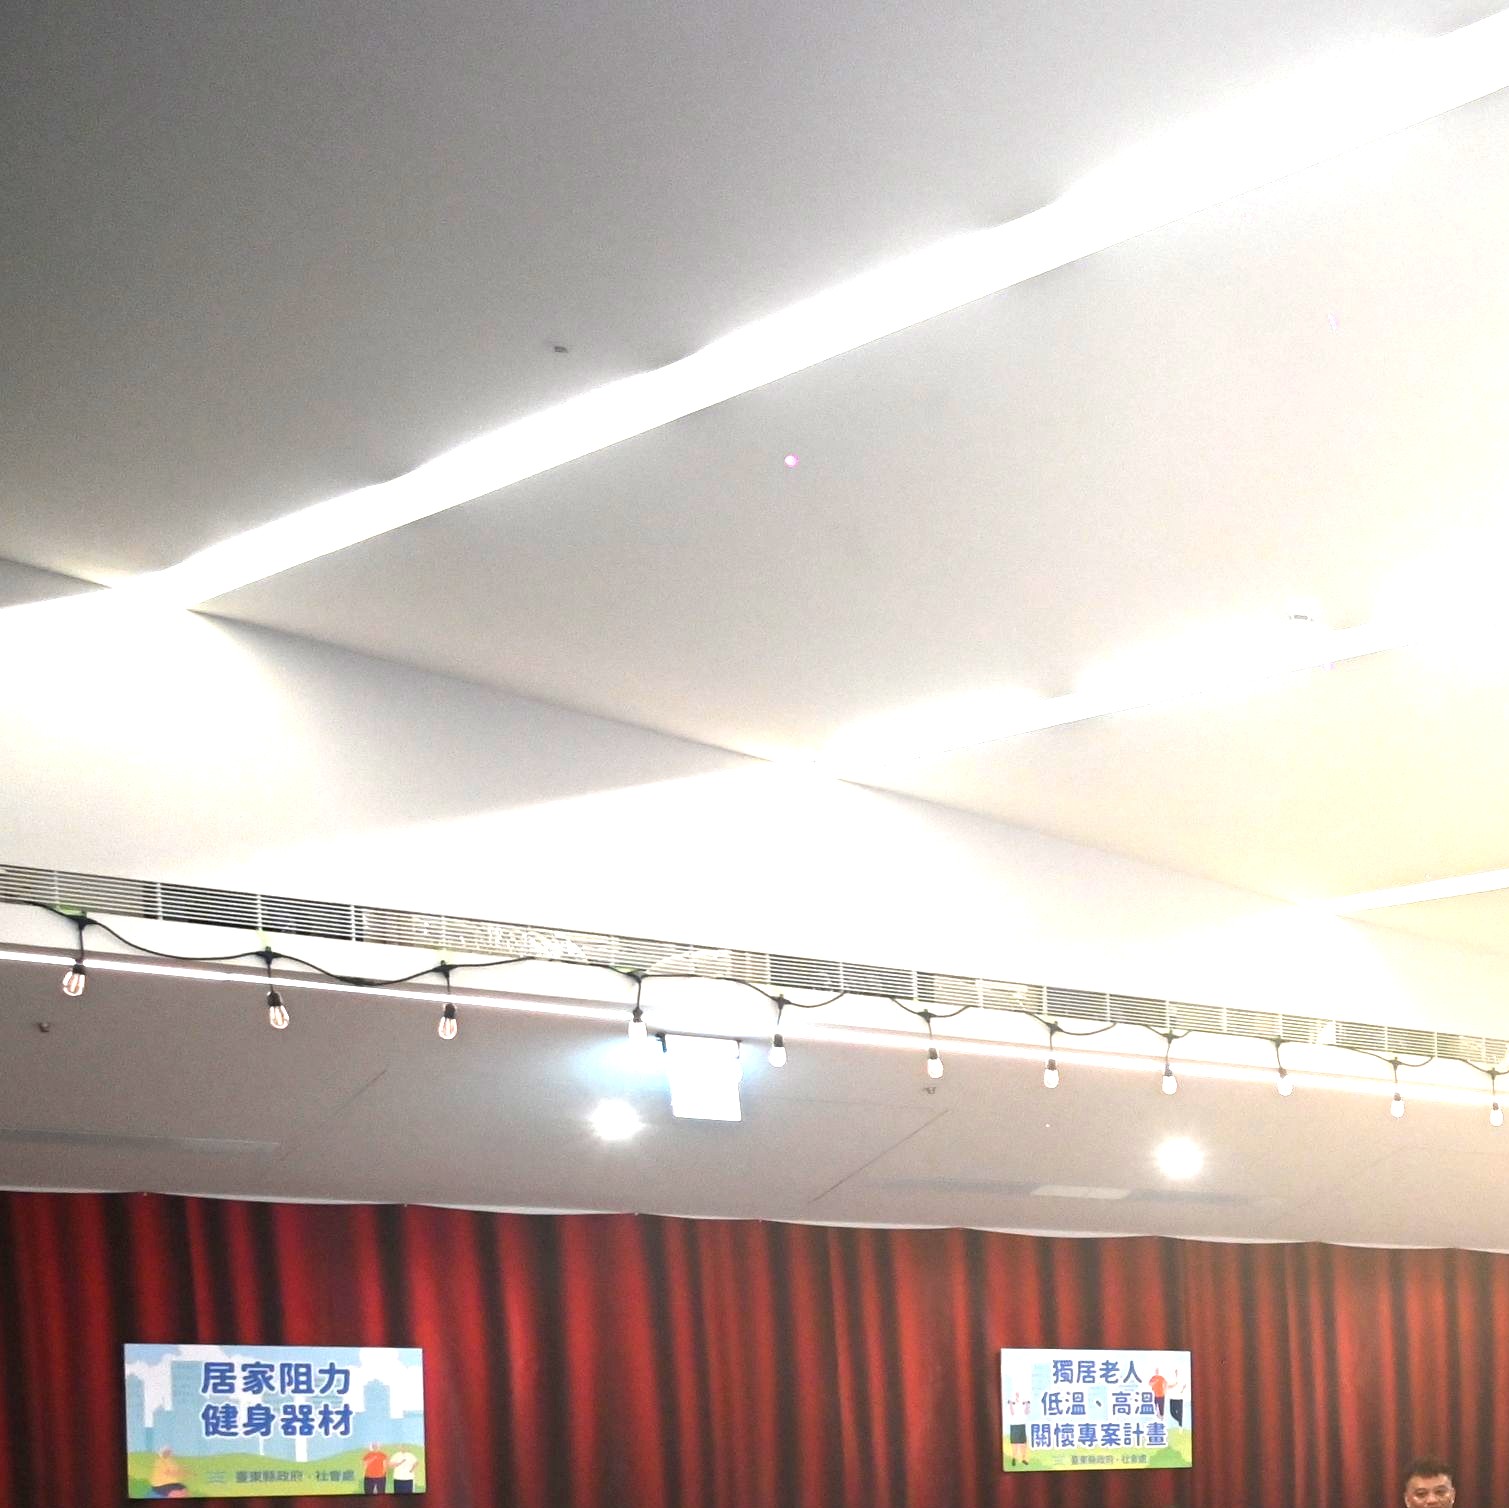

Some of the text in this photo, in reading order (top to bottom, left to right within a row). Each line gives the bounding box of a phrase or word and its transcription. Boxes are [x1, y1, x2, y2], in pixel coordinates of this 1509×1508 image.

[201, 1361, 351, 1395] 居家阻力
[1052, 1359, 1143, 1385] 獨居老人
[1041, 1391, 1156, 1416] 低溫、高溫
[201, 1403, 354, 1437] 健身器材
[1031, 1422, 1166, 1447] 關懷專案計畫
